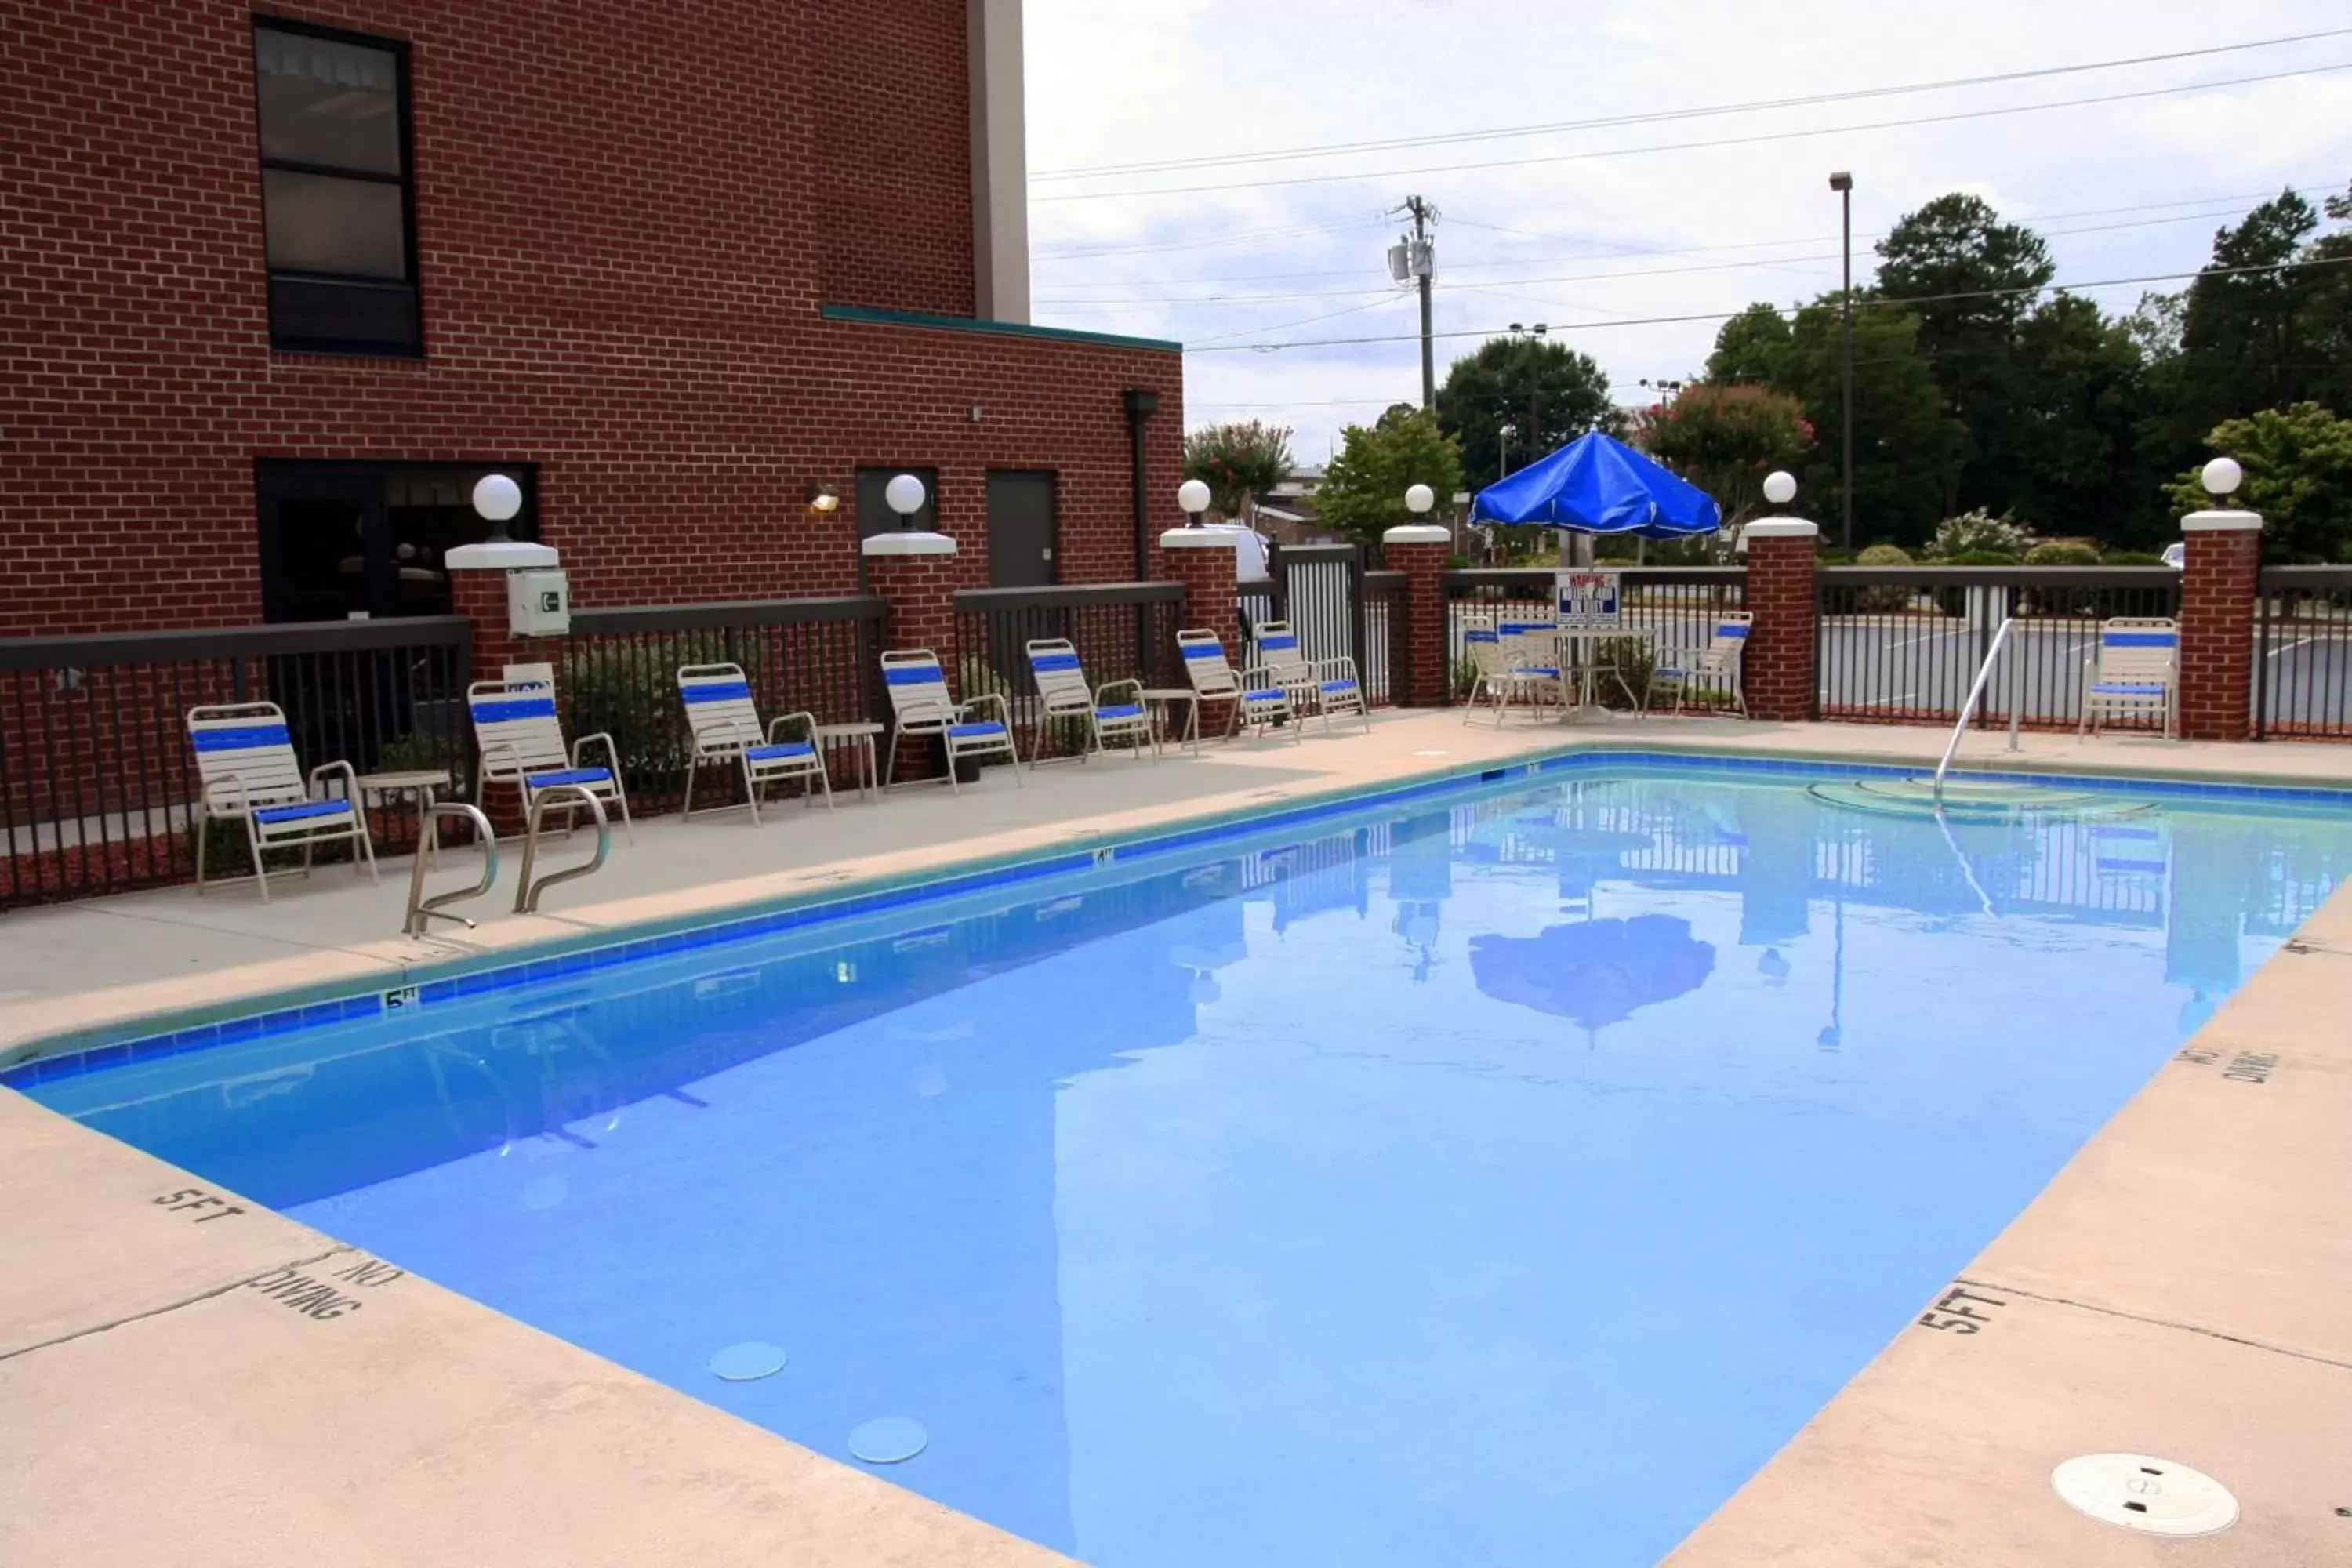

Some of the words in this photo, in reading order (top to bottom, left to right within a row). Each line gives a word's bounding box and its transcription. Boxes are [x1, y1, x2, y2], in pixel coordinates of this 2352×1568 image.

[153, 1188, 245, 1224] 5FT
[332, 1258, 405, 1287] NO
[1918, 1287, 2008, 1335] 5FT
